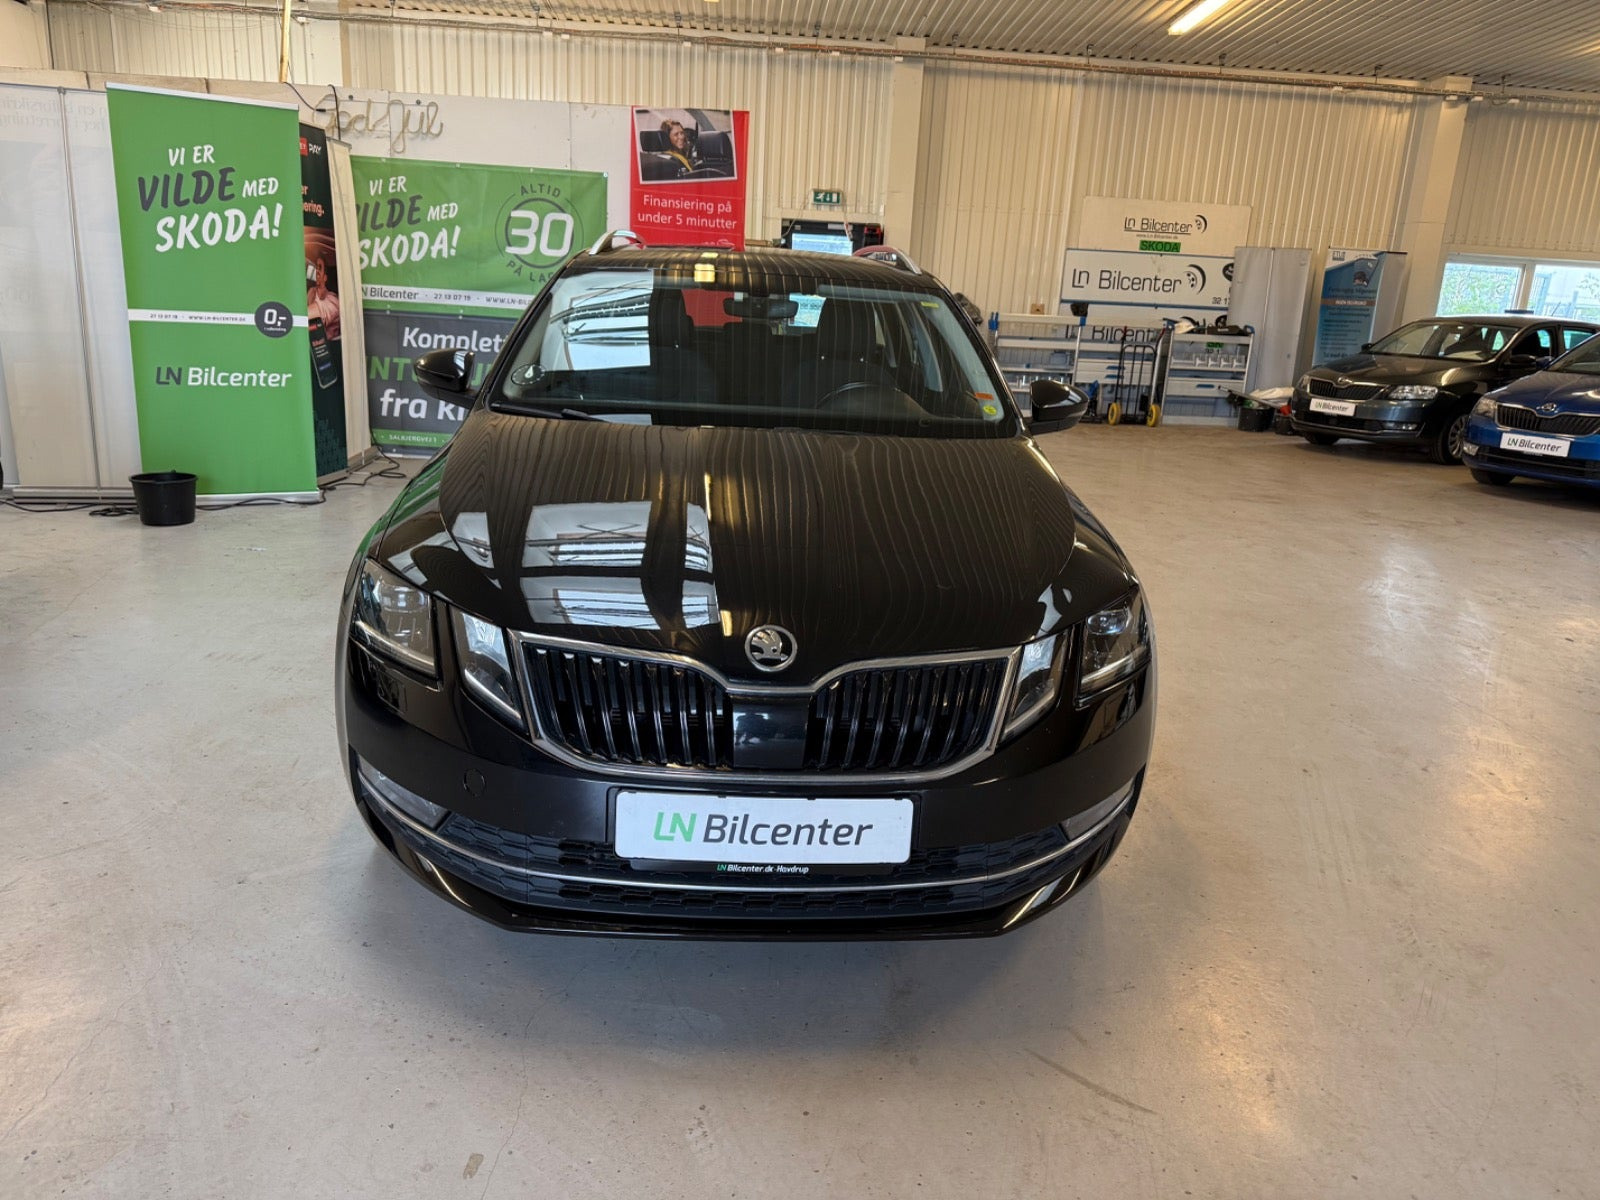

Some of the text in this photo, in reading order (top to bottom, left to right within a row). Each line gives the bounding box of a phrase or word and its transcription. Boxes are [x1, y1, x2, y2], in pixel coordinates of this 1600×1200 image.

[168, 144, 215, 167] VI ER
[138, 167, 279, 212] VILDE MED
[369, 175, 407, 197] VI ER
[520, 183, 561, 198] ALTID
[357, 194, 459, 232] ILDE MED
[643, 194, 732, 215] Finansiering på
[155, 203, 283, 252] SKODA!
[637, 212, 738, 230] under 5 minutter
[1140, 217, 1193, 233] Bilcenter
[505, 210, 574, 257] 30
[359, 225, 461, 271] SKODA!
[1140, 240, 1181, 253] SKODA
[506, 260, 523, 277] PÅ
[1098, 269, 1182, 293] Bilcenter
[370, 286, 419, 300] Bilcenter
[156, 366, 292, 388] LN Bilcenter
[380, 388, 428, 419] fra
[1518, 439, 1562, 452] Bilcenter
[653, 811, 873, 846] LN Bilcenter
